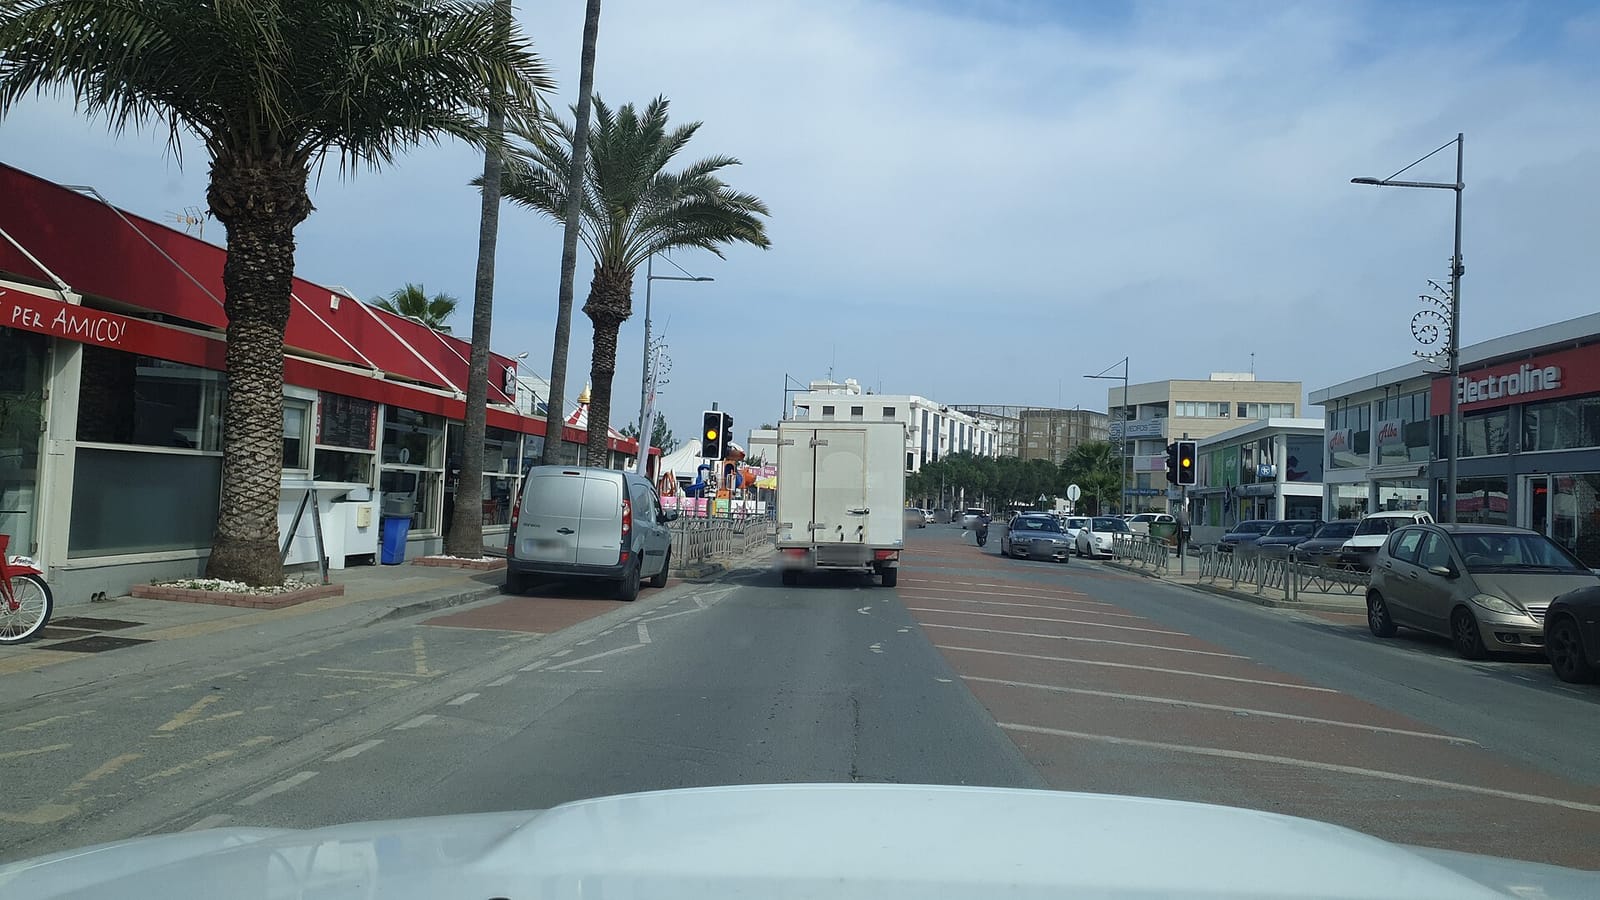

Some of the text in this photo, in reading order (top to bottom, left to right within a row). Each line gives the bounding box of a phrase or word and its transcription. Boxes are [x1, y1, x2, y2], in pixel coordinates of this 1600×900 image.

[11, 305, 126, 344] PER AMICO!
[1457, 363, 1561, 404] Electroline
